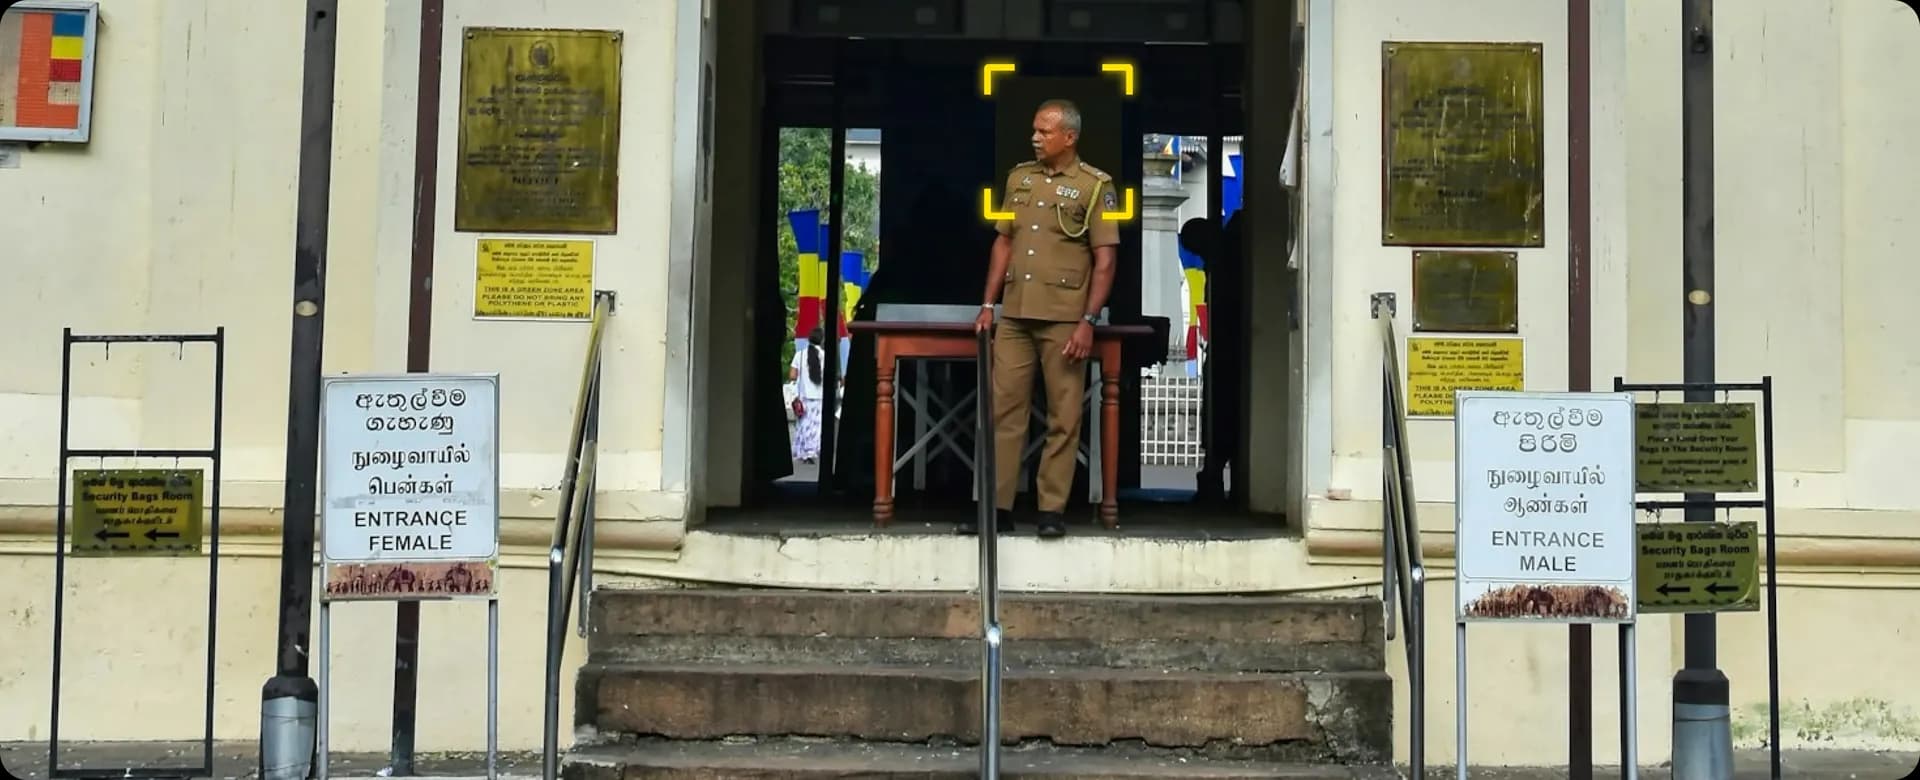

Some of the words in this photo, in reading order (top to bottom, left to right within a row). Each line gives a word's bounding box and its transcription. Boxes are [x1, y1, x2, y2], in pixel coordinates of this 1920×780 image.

[356, 388, 466, 412] ඇතුල්වීම
[366, 413, 453, 435] ගැහැණු
[1493, 407, 1603, 430] ඇතුල්වීම
[1518, 433, 1577, 453] පිරිමි
[352, 443, 470, 470] நுழைவாயில்
[1487, 464, 1606, 489] நுழைவாயில்
[82, 491, 128, 503] Security
[131, 491, 159, 503] Bags
[162, 490, 193, 501] Room
[1503, 493, 1588, 517] ஆண்கள்
[355, 510, 467, 527] ENTRANCE
[369, 535, 453, 551] FEMALE
[1491, 531, 1604, 548] ENTRANCE
[1641, 545, 1687, 557] Security
[1690, 545, 1717, 556] Bags
[1720, 544, 1750, 554] Room
[1520, 555, 1577, 572] MALE
